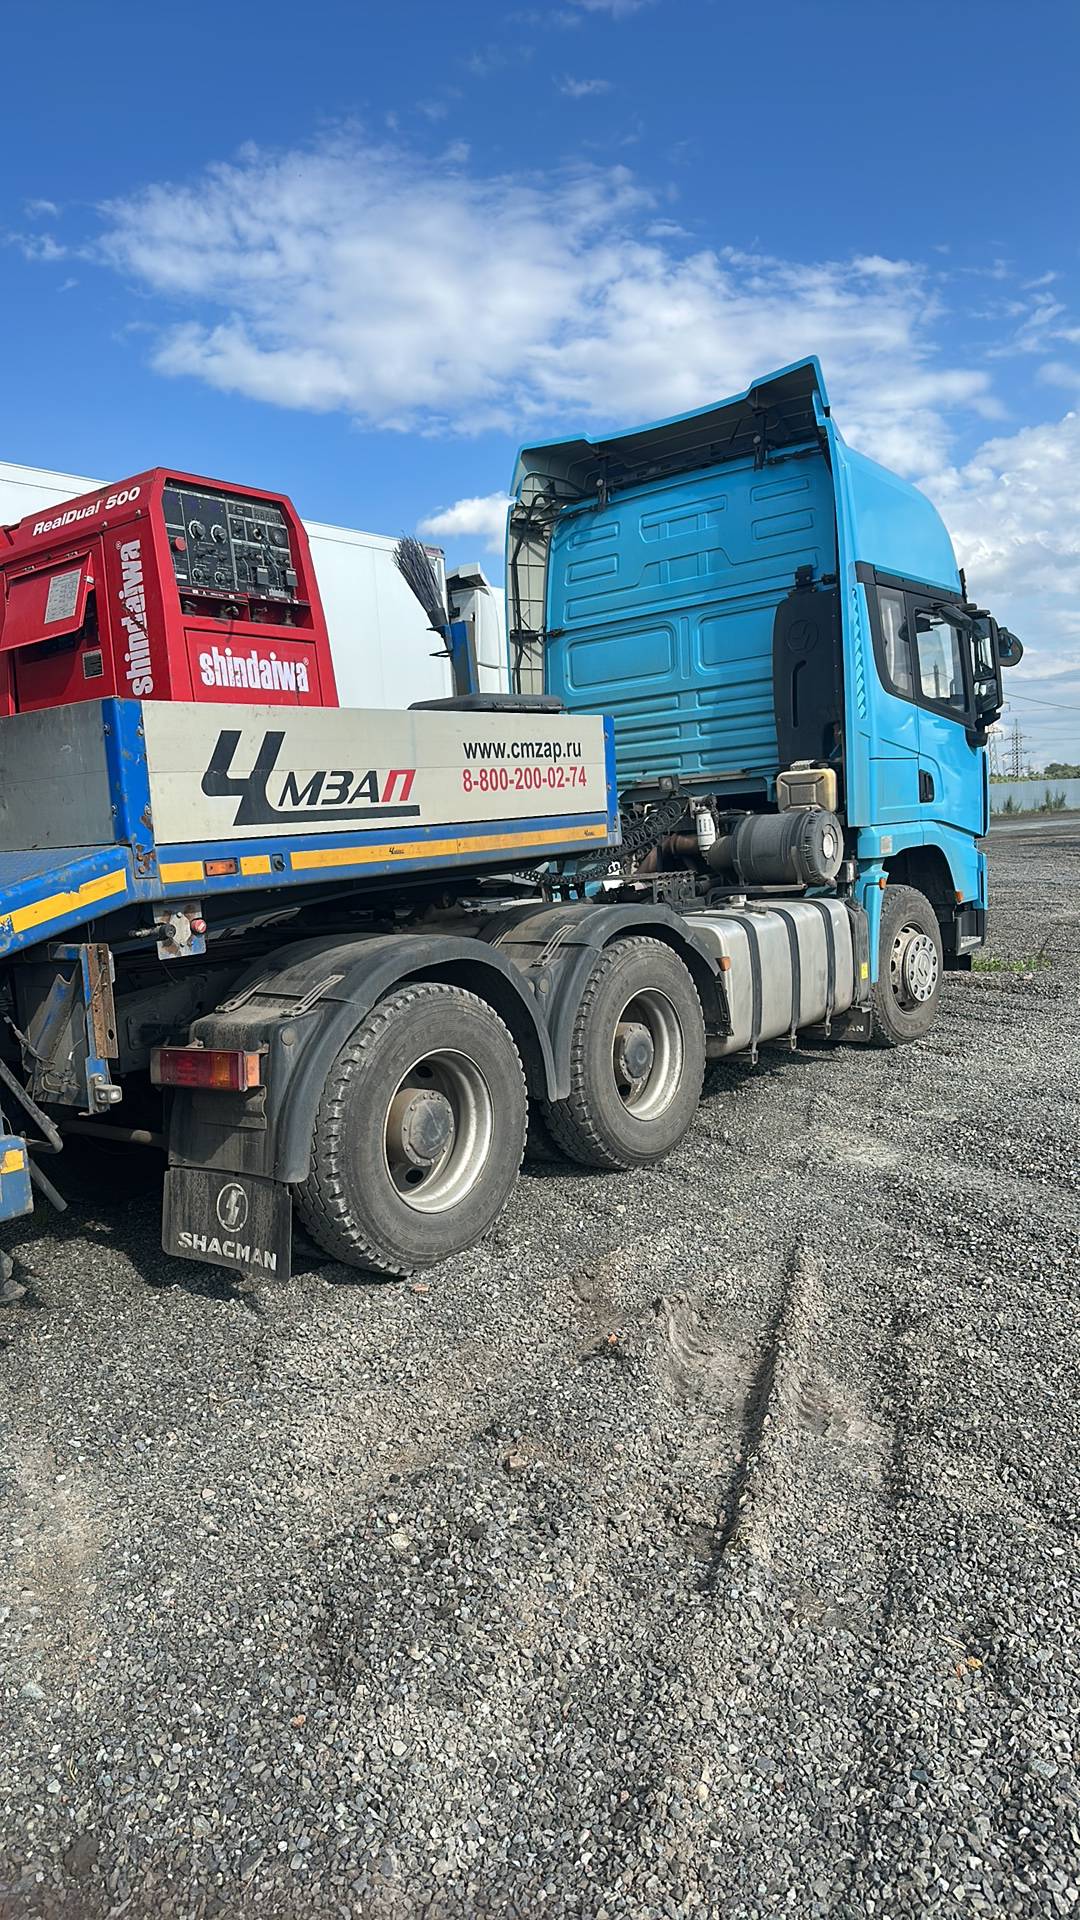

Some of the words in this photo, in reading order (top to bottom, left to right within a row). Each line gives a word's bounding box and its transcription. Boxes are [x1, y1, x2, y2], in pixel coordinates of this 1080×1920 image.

[32, 500, 102, 537] RealDual
[104, 486, 141, 510] 500
[119, 539, 154, 696] shindaiwa
[199, 646, 310, 692] shindaiwa
[463, 742, 582, 763] www.cmzap.ru
[463, 766, 587, 792] 8-800-200-02-74
[177, 1231, 278, 1271] SHACMAN
